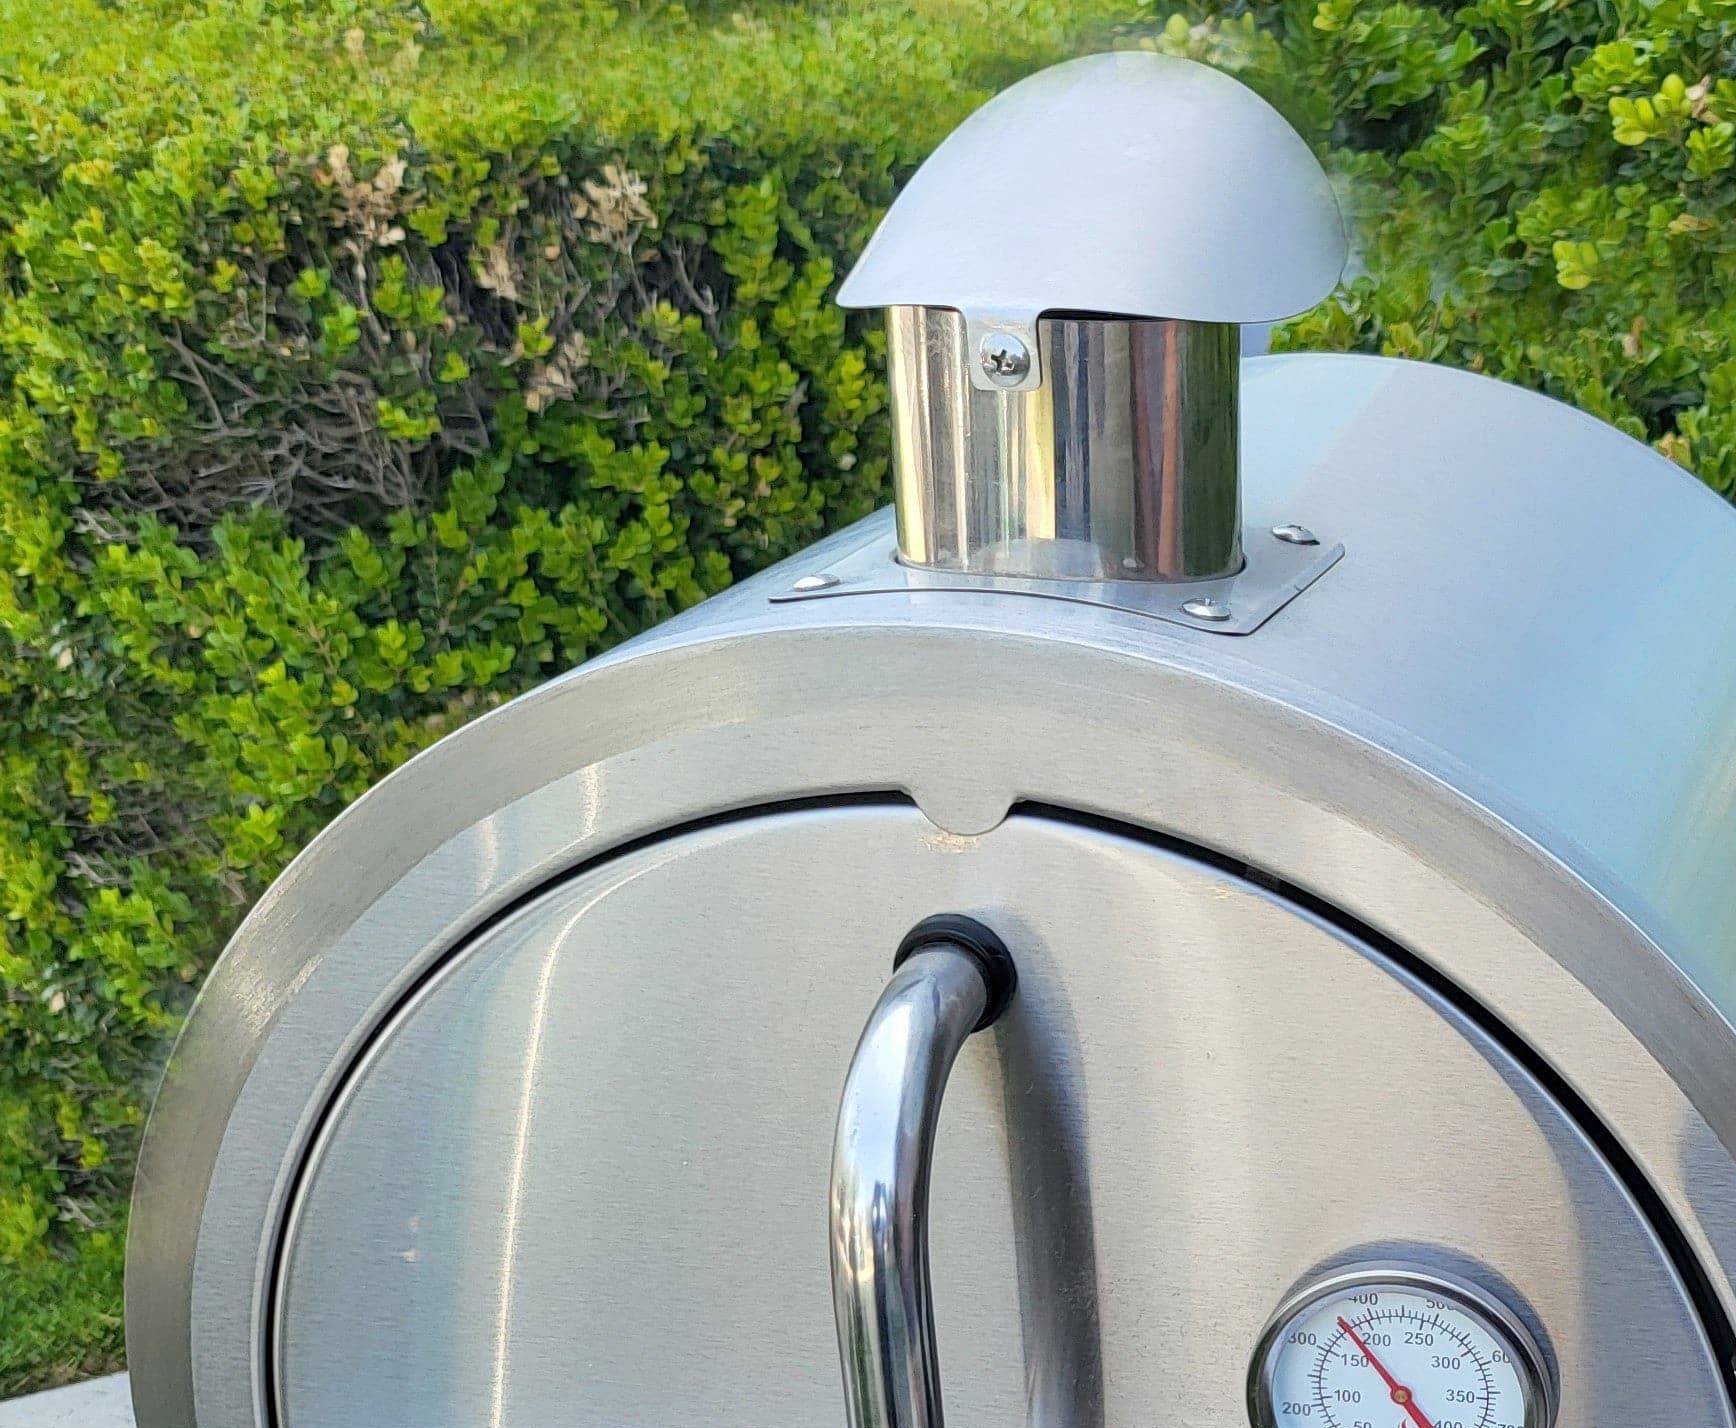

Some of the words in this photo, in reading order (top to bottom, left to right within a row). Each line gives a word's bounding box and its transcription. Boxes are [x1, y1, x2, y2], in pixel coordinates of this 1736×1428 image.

[1361, 1332, 1391, 1347] 200
[1404, 1331, 1434, 1347] 250
[1341, 1353, 1369, 1368] 150
[1431, 1355, 1460, 1370] 300
[1333, 1389, 1361, 1403] 100
[1445, 1389, 1475, 1403] 350
[1282, 1401, 1311, 1416] 200
